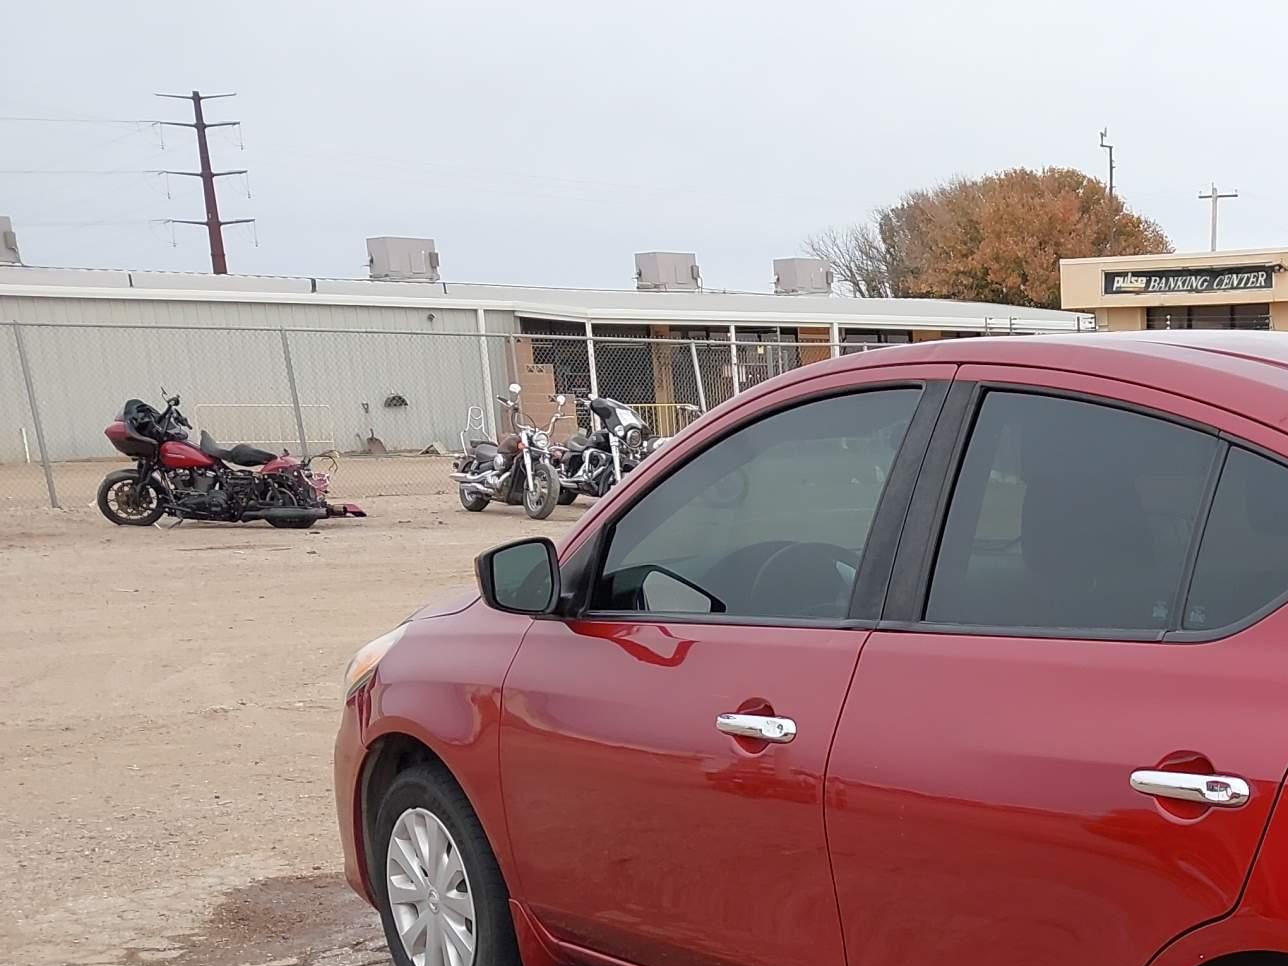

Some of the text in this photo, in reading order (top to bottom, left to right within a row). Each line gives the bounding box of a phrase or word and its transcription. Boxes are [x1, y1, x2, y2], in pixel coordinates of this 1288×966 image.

[1113, 271, 1267, 291] pulse BANKING CENTER
